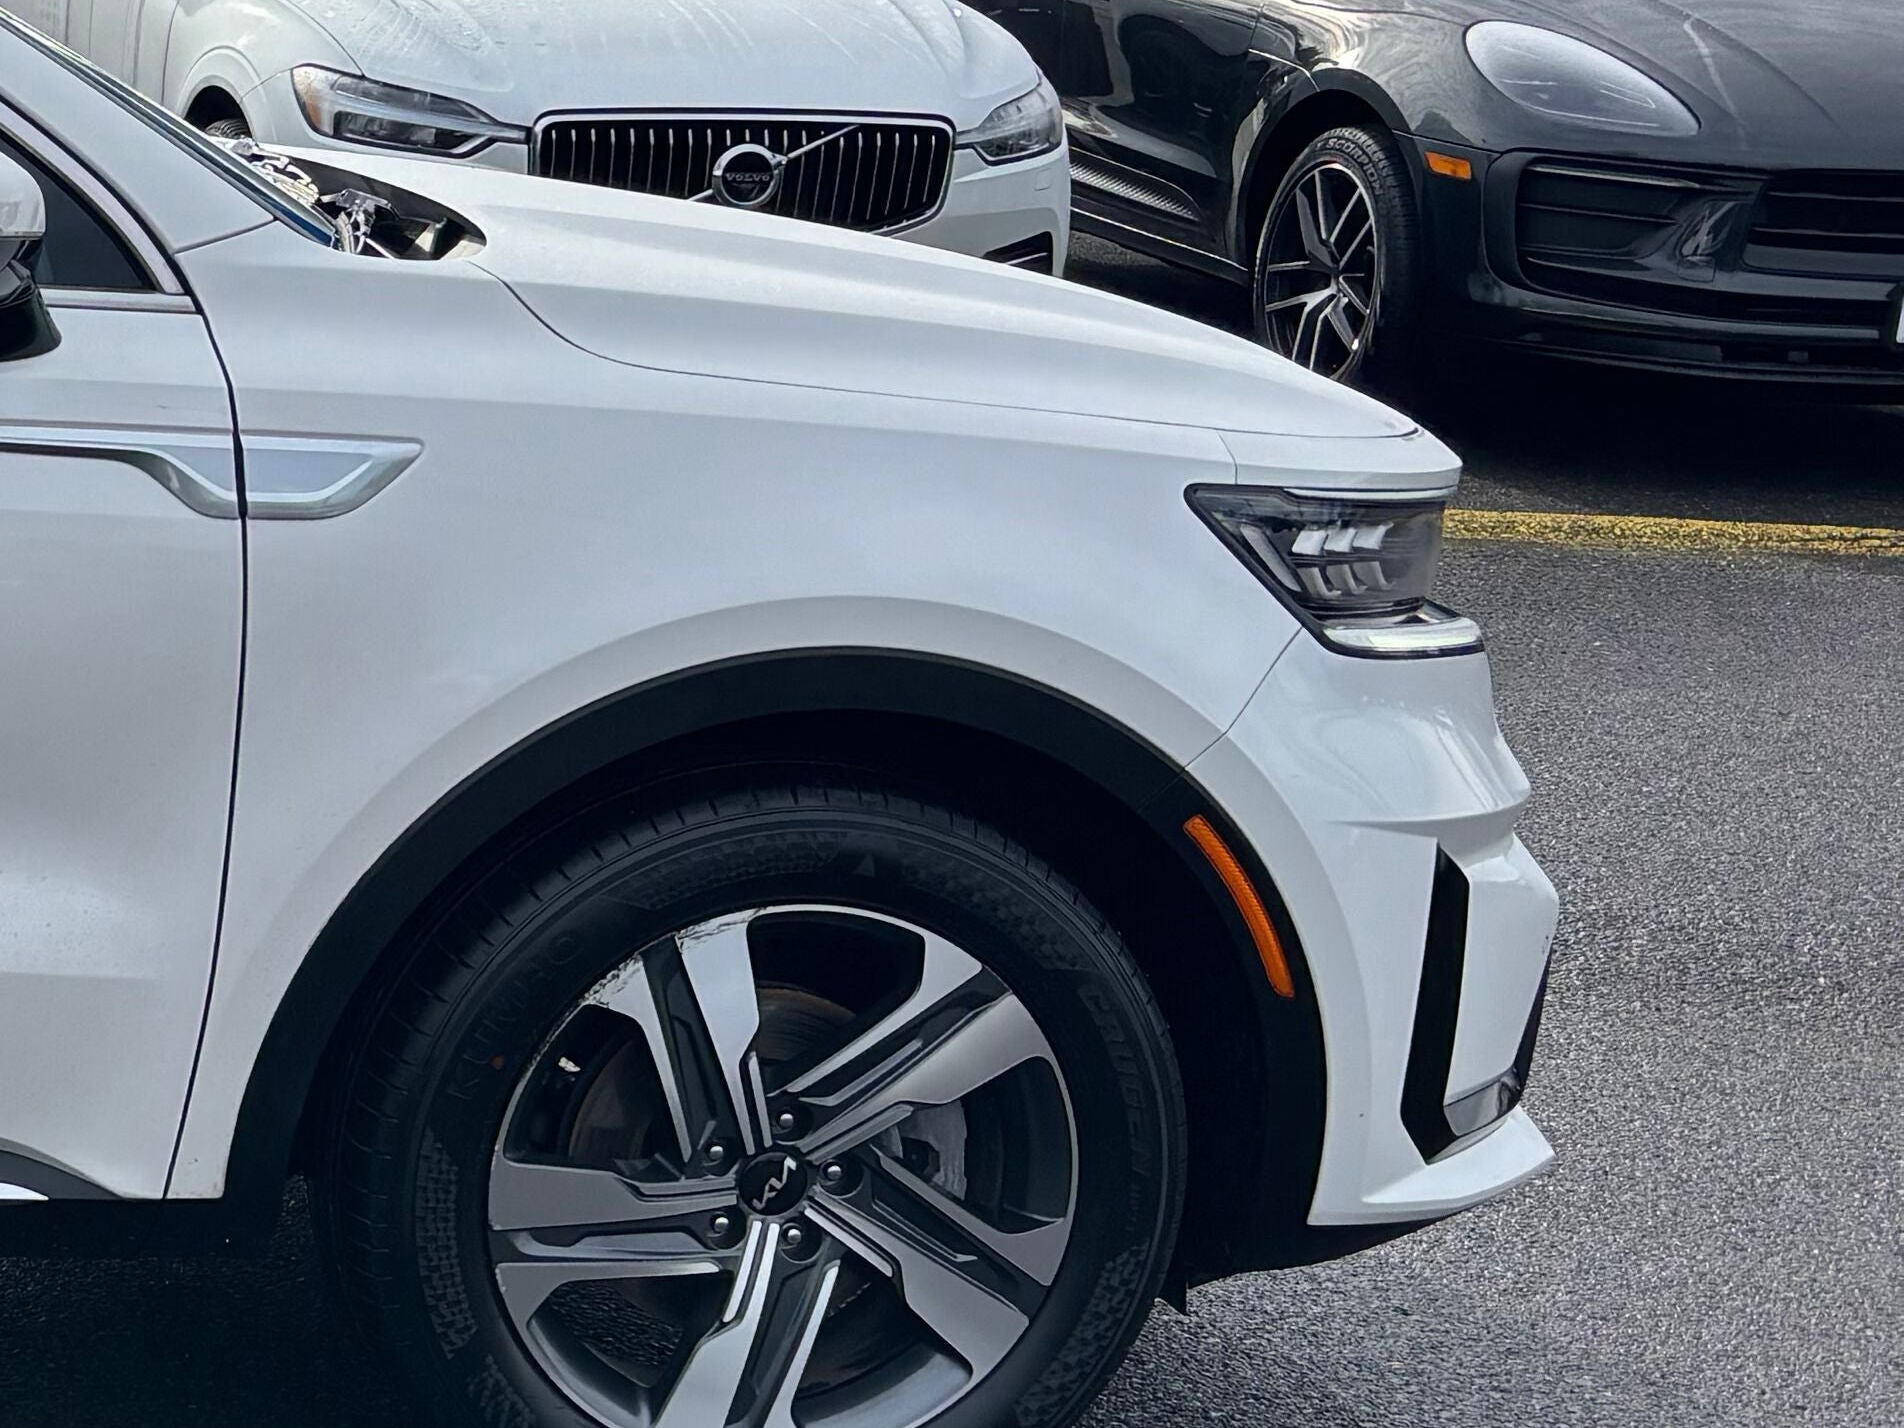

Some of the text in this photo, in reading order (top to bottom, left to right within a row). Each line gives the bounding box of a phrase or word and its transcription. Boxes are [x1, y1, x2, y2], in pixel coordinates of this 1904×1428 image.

[725, 172, 770, 182] VOLVO
[1325, 138, 1384, 195] SCORPION
[753, 1156, 797, 1210] KIA
